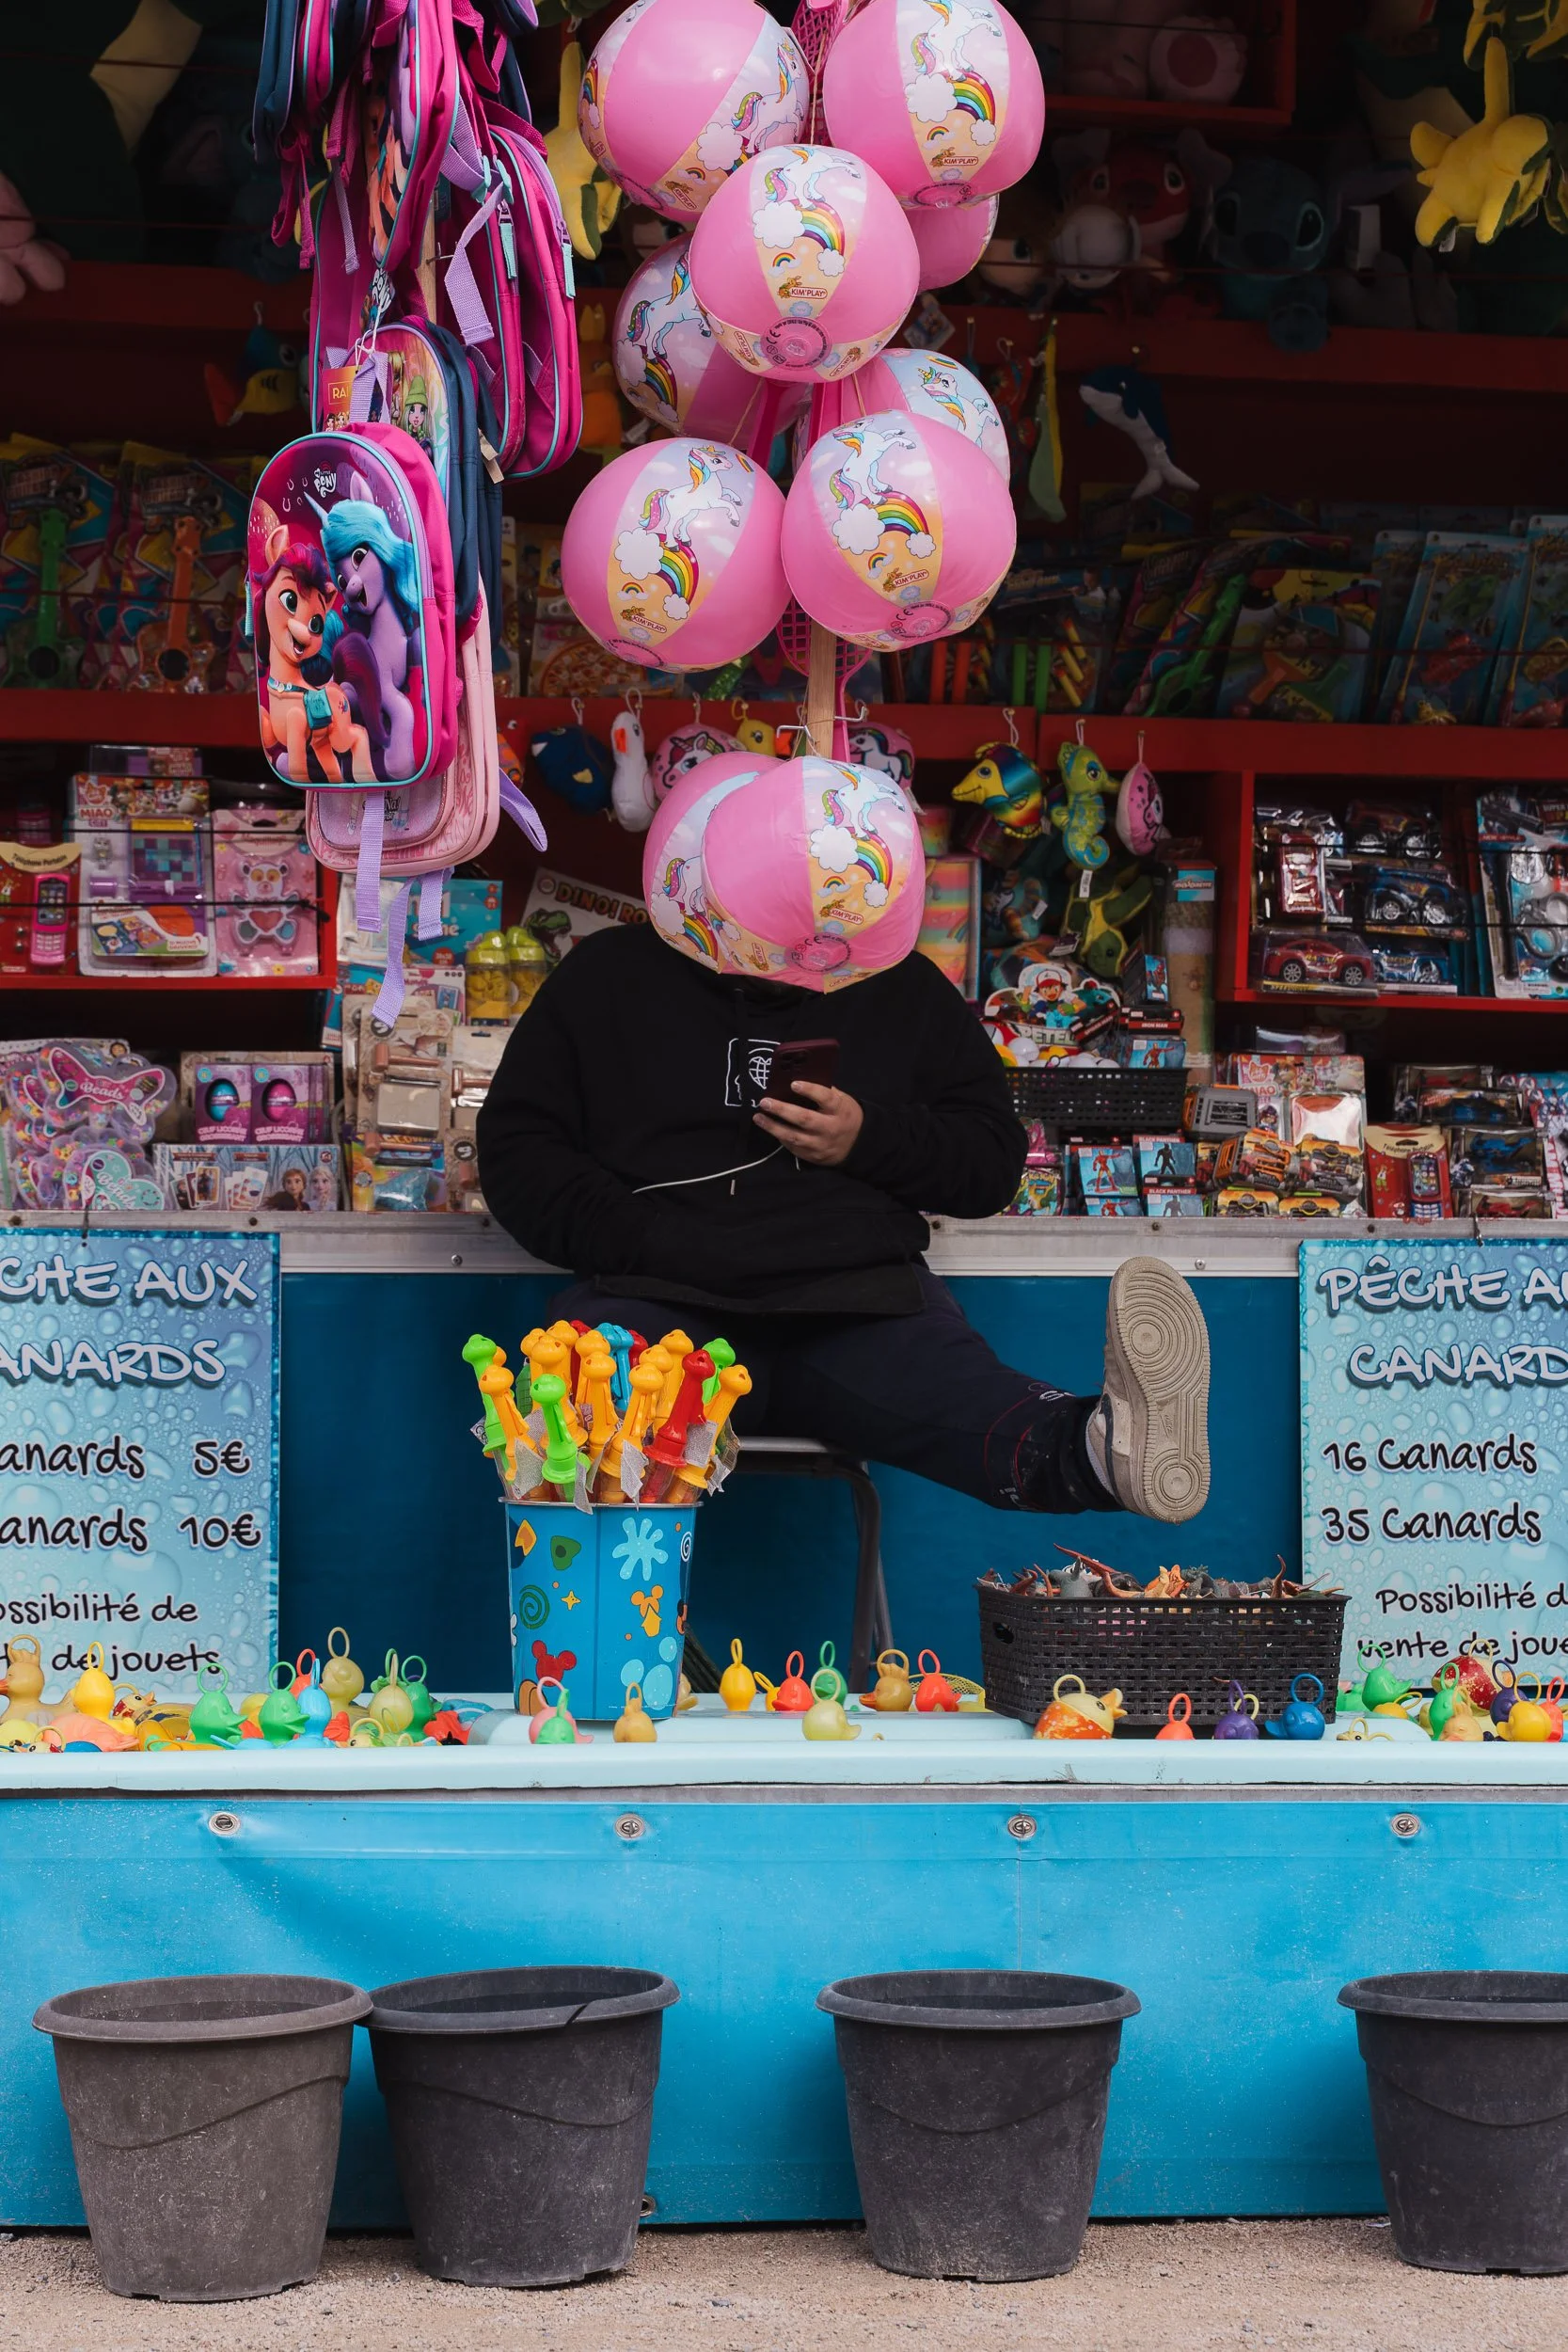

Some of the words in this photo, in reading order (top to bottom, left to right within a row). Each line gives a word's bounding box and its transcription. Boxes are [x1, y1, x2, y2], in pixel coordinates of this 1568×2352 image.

[791, 288, 825, 297] KIM'PLAY
[313, 472, 337, 499] PONY
[895, 571, 927, 585] KIM'PLAY
[633, 615, 666, 631] KIM'PLAY
[80, 808, 113, 818] MIAO
[80, 1082, 123, 1100] Beads
[0, 1254, 119, 1301] CHE
[135, 1258, 258, 1302] AUX
[1319, 1254, 1508, 1311] PÊCHE
[193, 1440, 251, 1476] 5€
[1323, 1442, 1367, 1473] 16
[1378, 1432, 1539, 1475] Canards
[180, 1515, 261, 1549] 10€
[1321, 1506, 1370, 1543] 35
[1381, 1502, 1543, 1544] Canards
[151, 1596, 198, 1623] de
[1374, 1581, 1538, 1615] Possibilité
[1356, 1629, 1449, 1660] vente
[1459, 1629, 1500, 1660] de
[52, 1643, 97, 1671] de
[110, 1645, 222, 1680] jouets
